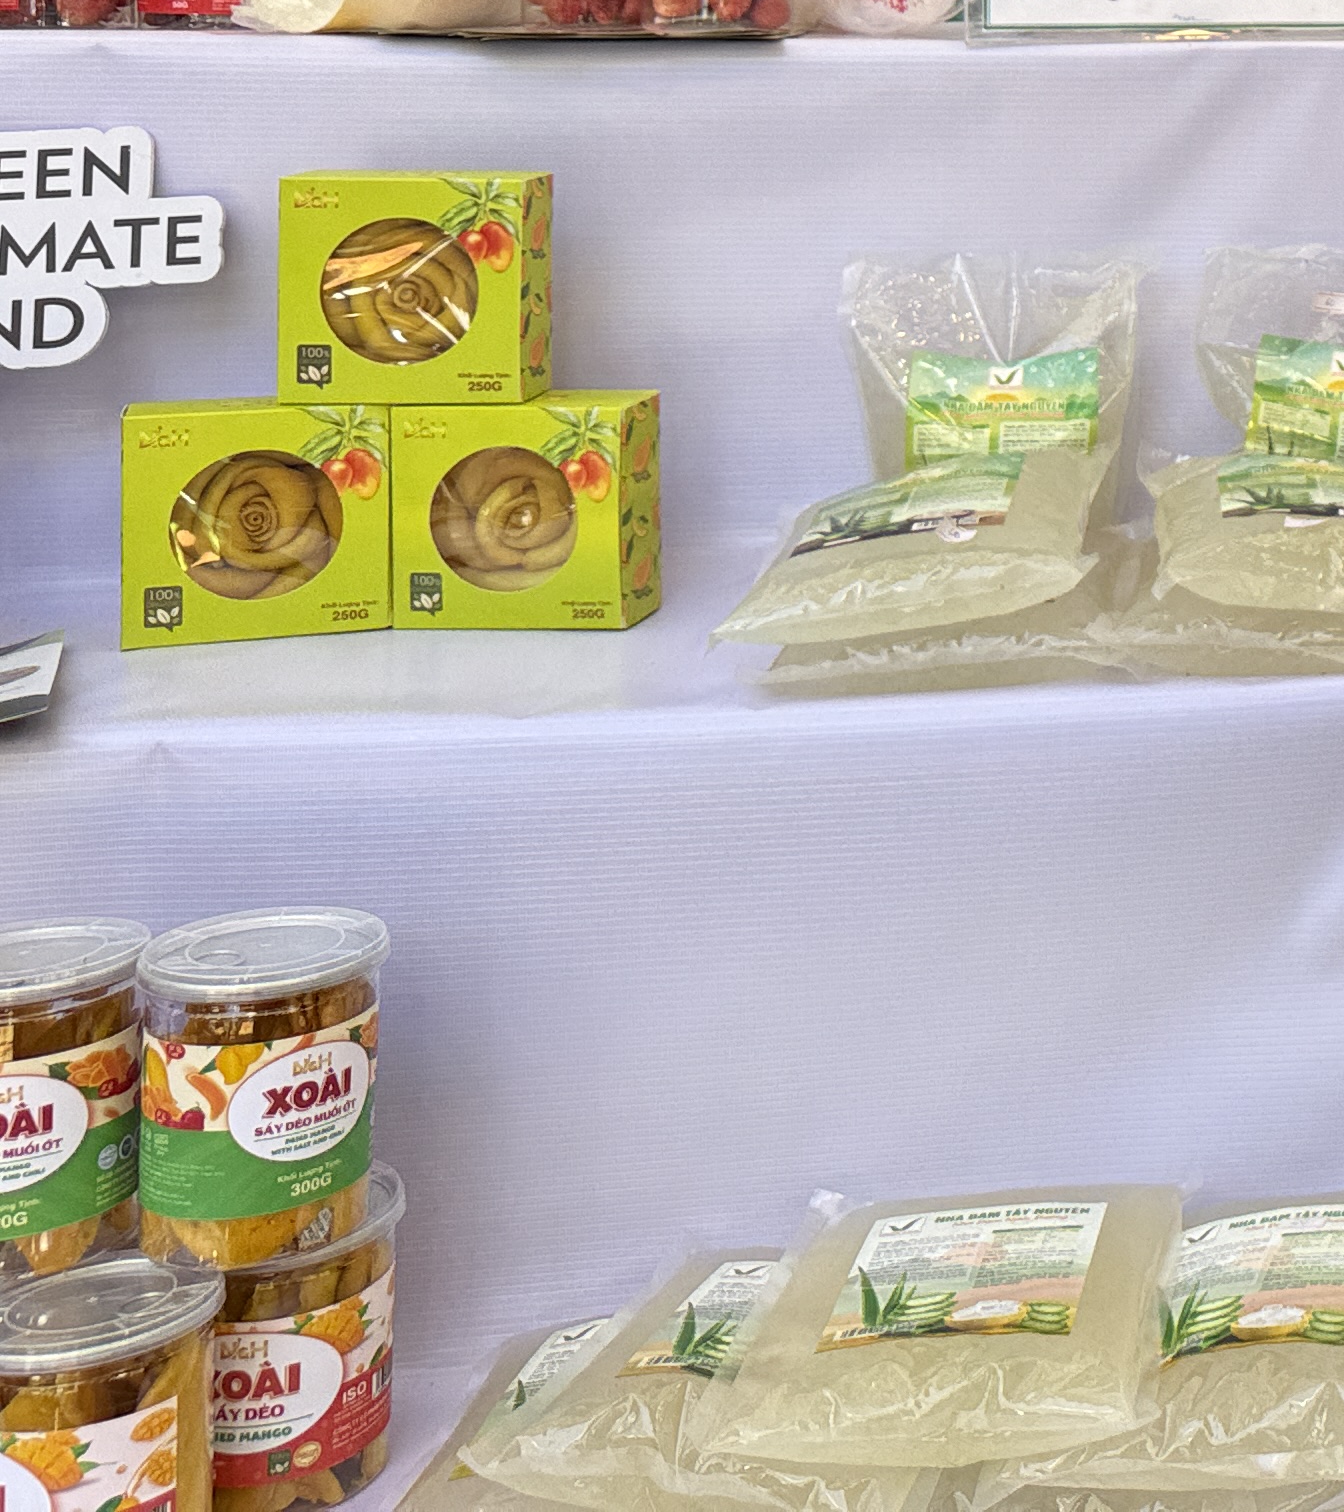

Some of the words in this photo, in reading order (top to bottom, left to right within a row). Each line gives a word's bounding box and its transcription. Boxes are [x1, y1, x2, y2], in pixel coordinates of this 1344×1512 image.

[0, 144, 131, 200] EEN
[0, 214, 203, 276] MATE
[467, 380, 503, 392] 250G
[331, 608, 370, 621] 250G
[572, 608, 605, 619] 250G
[261, 1065, 353, 1120] XOÀI
[0, 1102, 54, 1142] ÀI
[313, 1106, 342, 1124] MUỐI
[3, 1140, 40, 1159] MUỐI
[42, 1138, 64, 1151] ỚT
[290, 1171, 333, 1197] 300G
[0, 1210, 28, 1229] 0G
[341, 1380, 367, 1404] ISO
[213, 1404, 242, 1422] ẤY
[244, 1403, 285, 1422] DẺO
[214, 1432, 236, 1444] IED
[239, 1426, 293, 1443] MANGO
